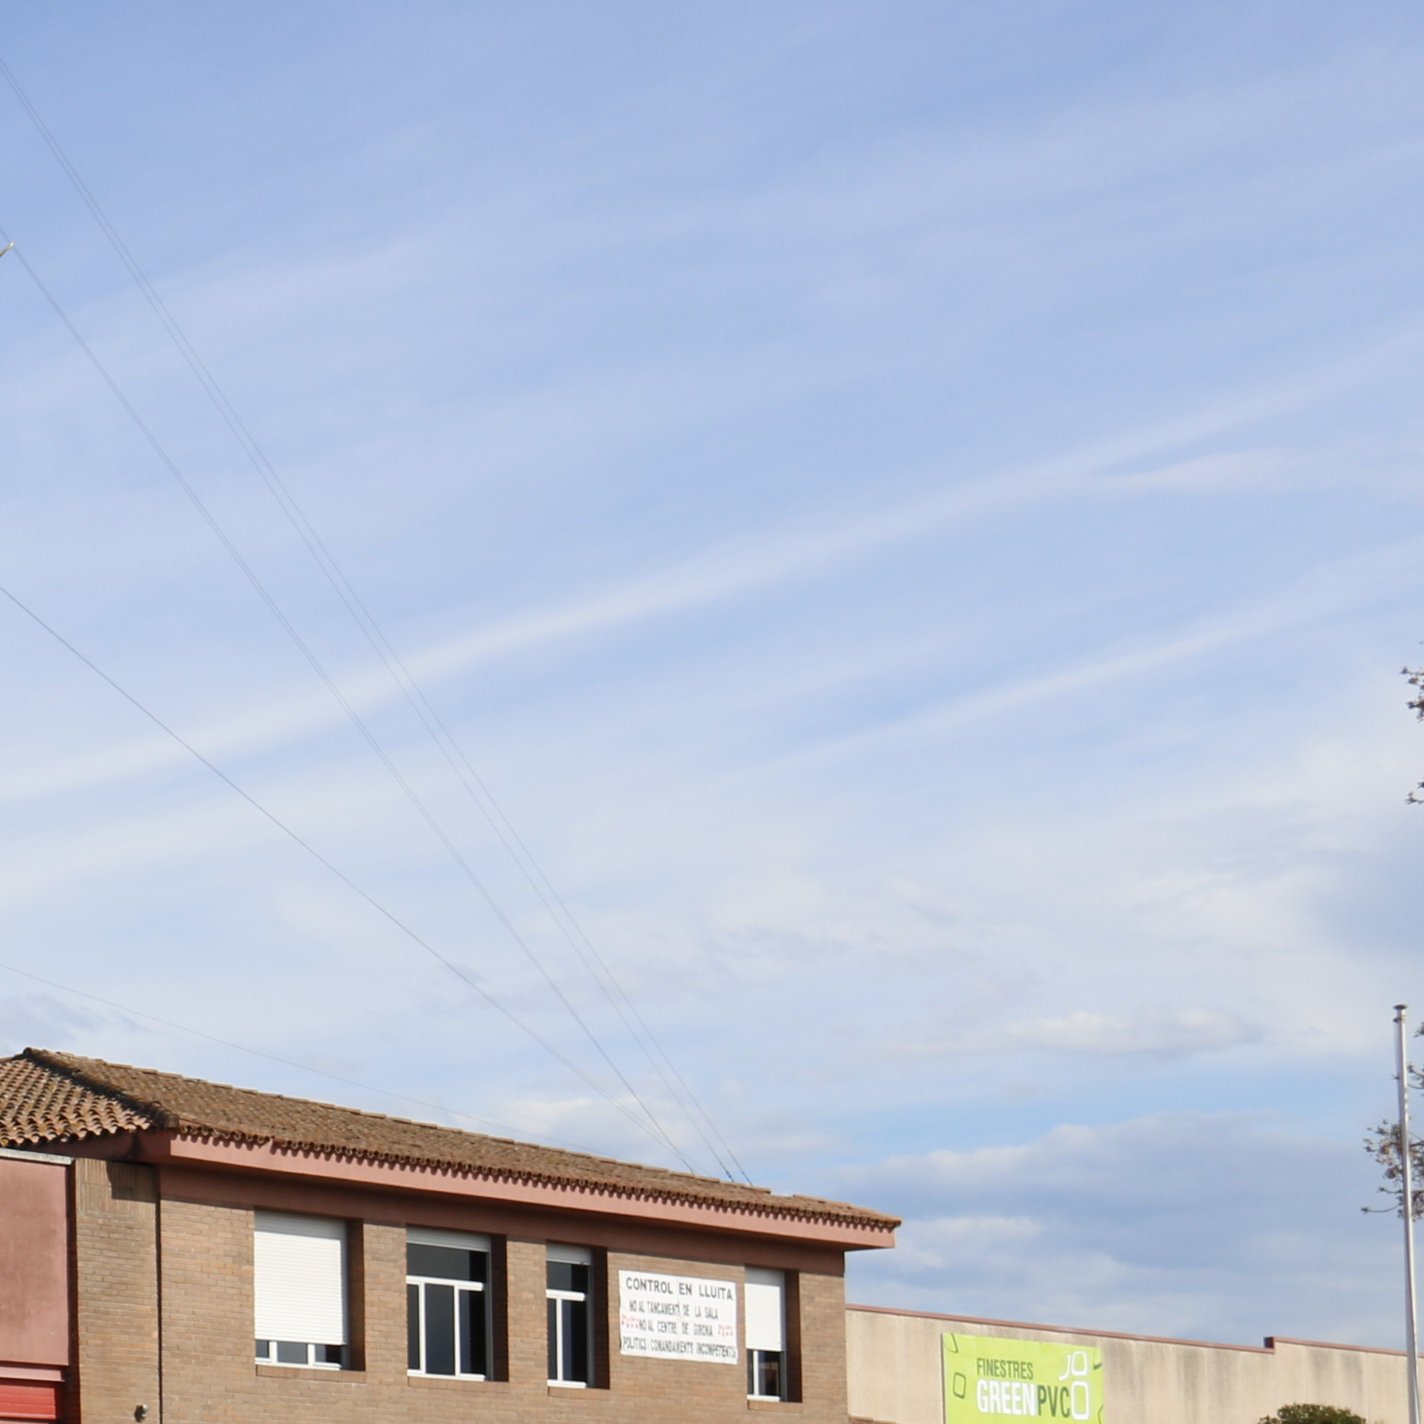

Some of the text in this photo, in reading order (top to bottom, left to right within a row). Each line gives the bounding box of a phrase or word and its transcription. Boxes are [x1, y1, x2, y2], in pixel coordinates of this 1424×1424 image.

[626, 1277, 733, 1300] CONTROL EN LLUITA
[976, 1358, 1034, 1380] FINESTRES
